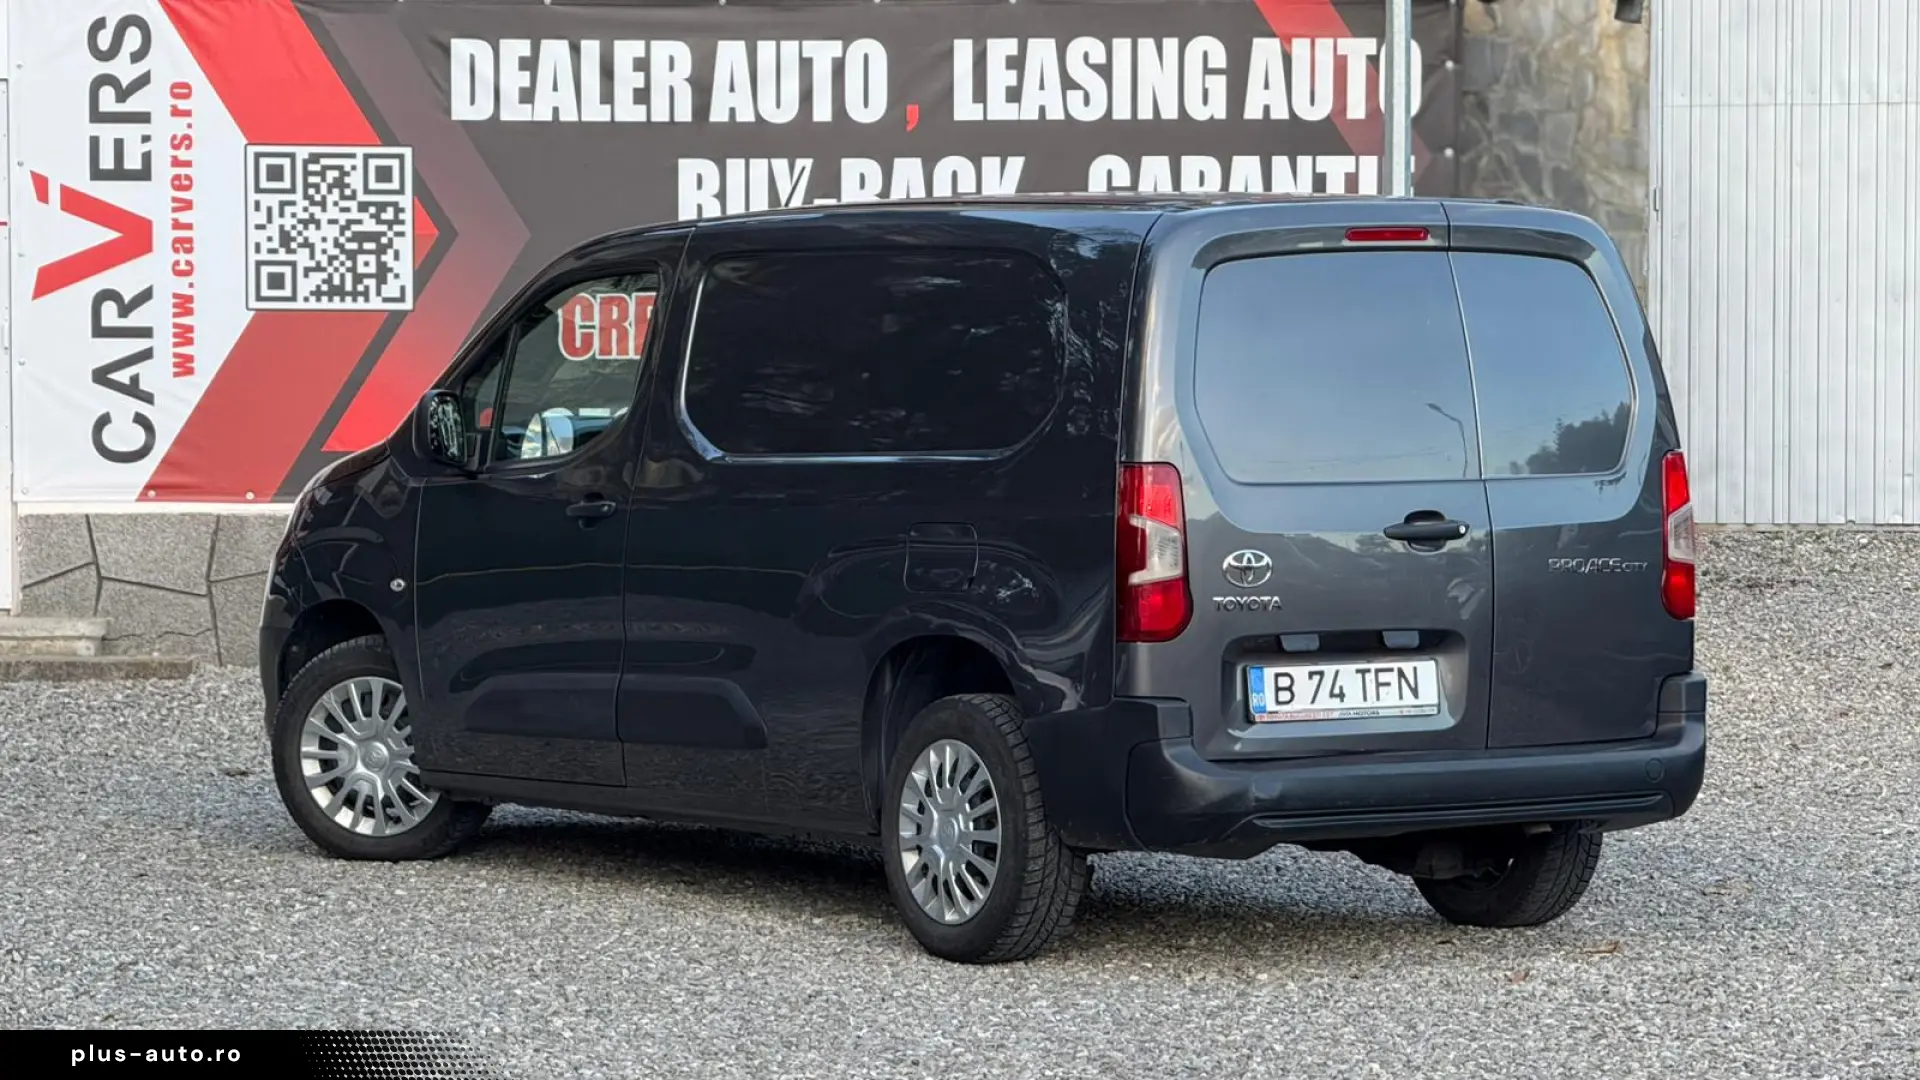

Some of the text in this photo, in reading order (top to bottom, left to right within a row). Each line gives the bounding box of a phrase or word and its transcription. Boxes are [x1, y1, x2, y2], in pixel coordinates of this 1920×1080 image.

[450, 37, 693, 122] DEALER
[708, 37, 889, 125] AUTO
[952, 35, 1228, 122] LEASING
[29, 12, 157, 465] CARVERS
[168, 80, 197, 379] www.carvers.ro
[1548, 557, 1622, 574] PROACE
[1212, 594, 1283, 613] TOYOTA
[1273, 665, 1420, 706] B 74 TFN
